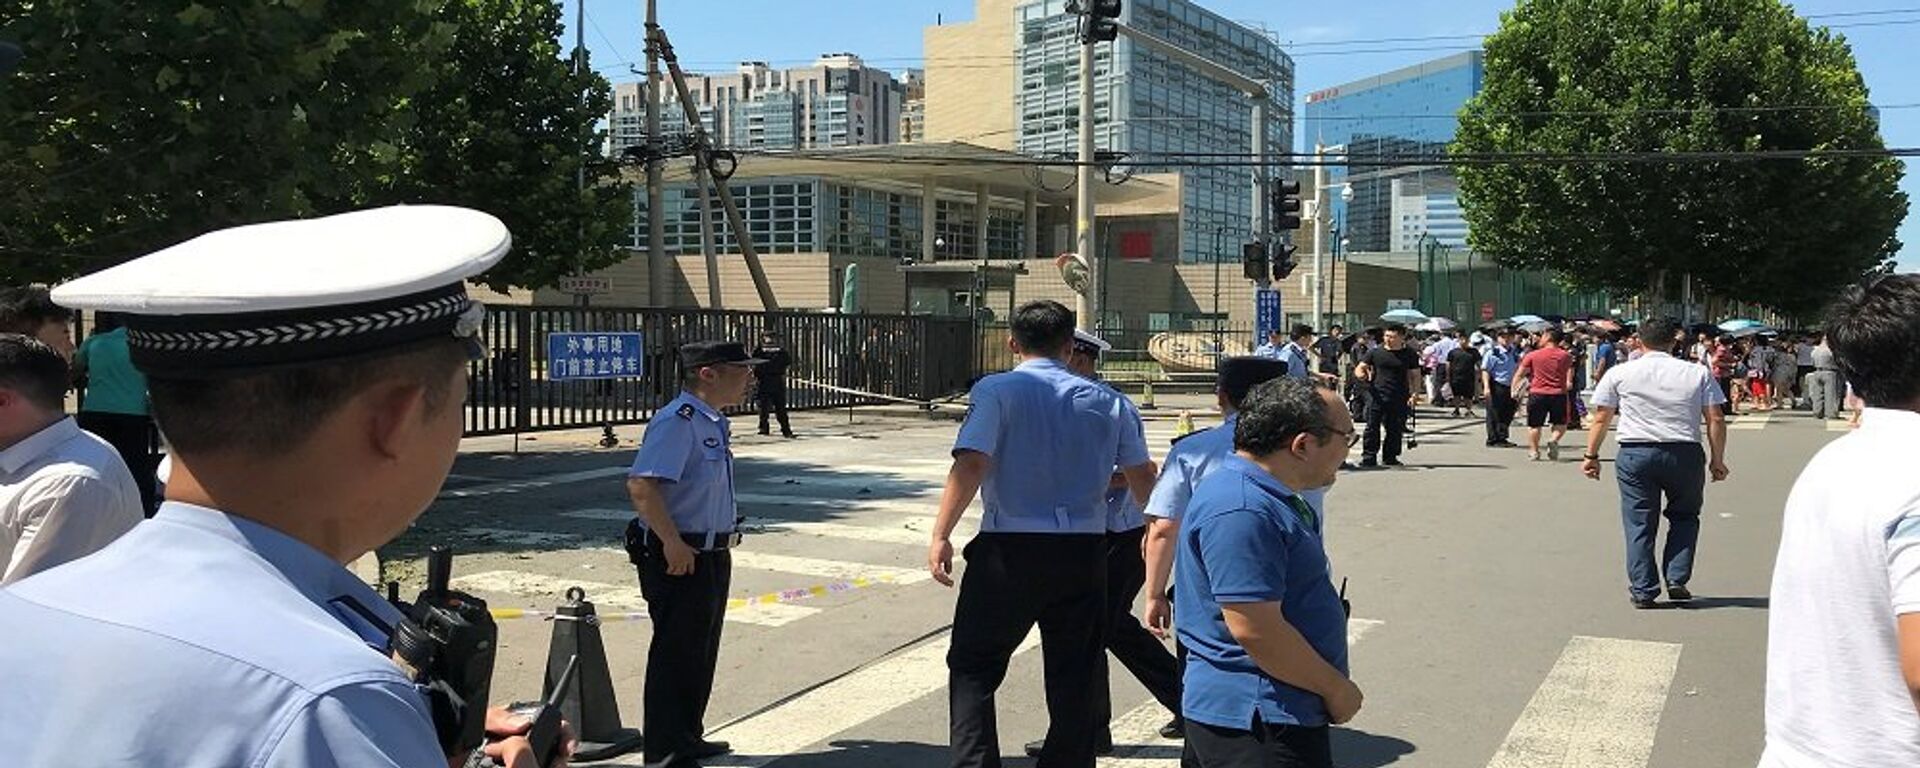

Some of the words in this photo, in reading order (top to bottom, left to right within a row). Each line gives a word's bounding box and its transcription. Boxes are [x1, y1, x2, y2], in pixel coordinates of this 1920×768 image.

[567, 336, 622, 354] 外事用地
[553, 356, 637, 376] 门前禁止停车
